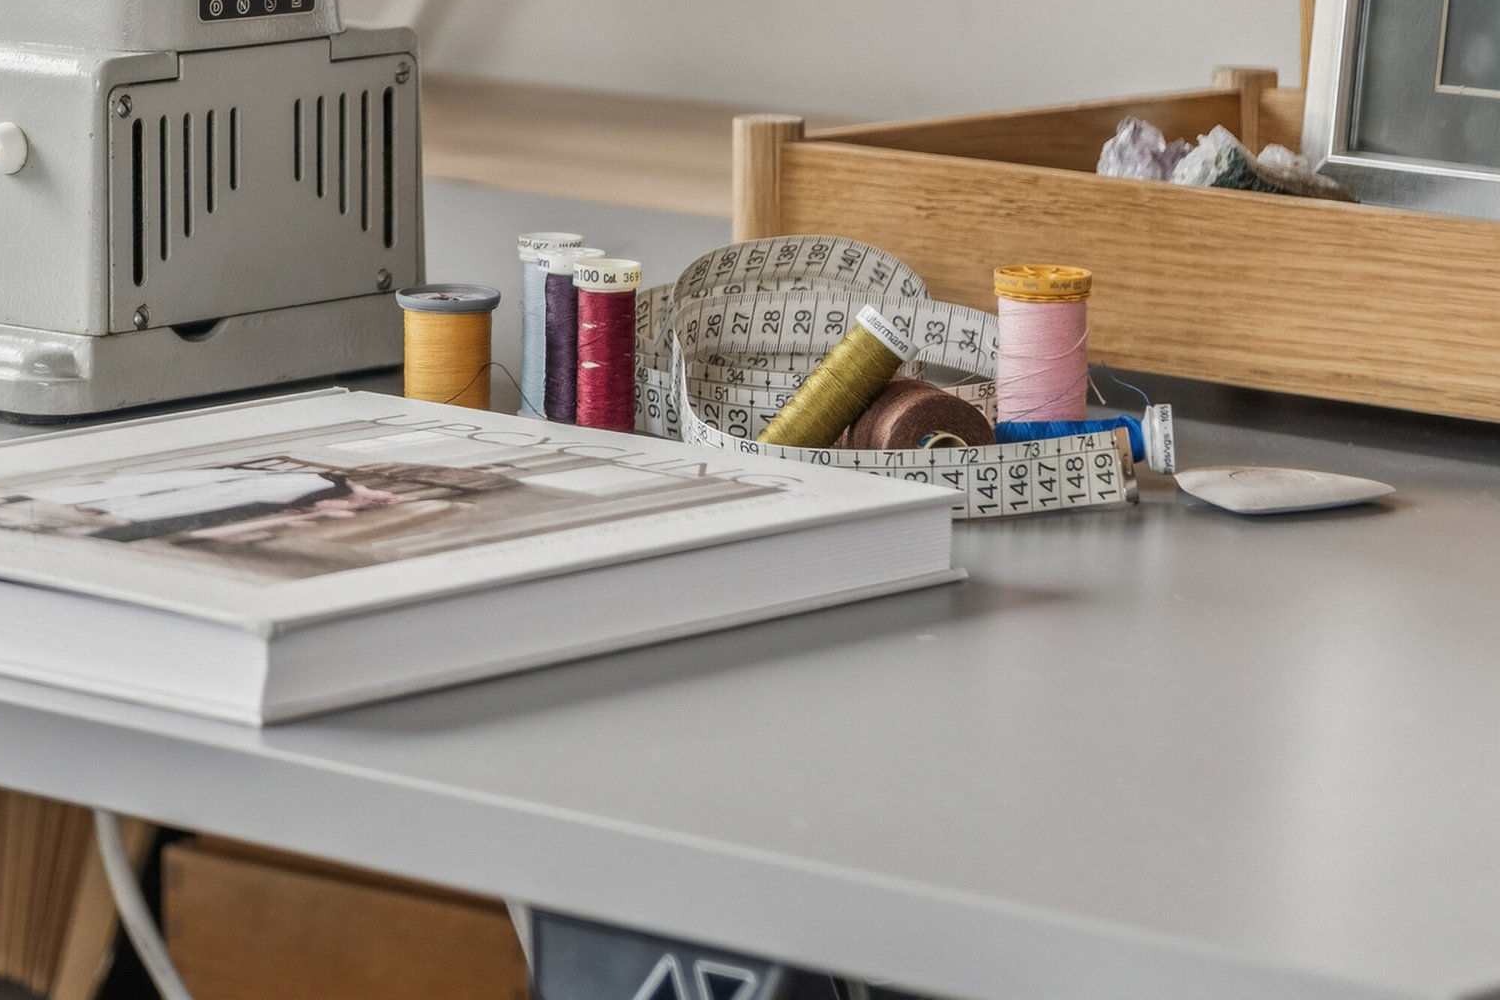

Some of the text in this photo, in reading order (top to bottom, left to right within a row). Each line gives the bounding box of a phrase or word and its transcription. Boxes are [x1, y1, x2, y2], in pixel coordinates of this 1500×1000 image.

[603, 274, 618, 284] Col.
[715, 251, 737, 278] 136
[745, 249, 766, 272] 137
[775, 244, 798, 268] 138
[805, 243, 829, 267] 139
[837, 248, 861, 272] 140
[869, 261, 892, 287] 141
[637, 300, 649, 334] 113
[687, 320, 698, 346] 25
[706, 314, 722, 339] 26
[732, 312, 750, 334] 27
[762, 310, 781, 334] 28
[793, 310, 812, 334] 29
[825, 310, 845, 335] 30
[925, 320, 945, 345] 33
[959, 328, 979, 353] 34
[727, 369, 744, 383] 34
[978, 382, 996, 398] 55
[648, 389, 660, 418] 99
[714, 387, 729, 401] 51
[705, 404, 720, 430] 02
[729, 409, 748, 438] 03
[373, 414, 803, 491] UPCYCLING
[740, 441, 759, 455] 69
[809, 450, 831, 465] 70
[884, 452, 904, 466] 71
[958, 448, 979, 464] 72
[1023, 442, 1041, 459] 73
[1077, 434, 1096, 450] 74
[977, 467, 999, 514] 145
[1009, 464, 1029, 511] 146
[1038, 462, 1057, 507] 147
[1066, 456, 1087, 503] 148
[1095, 453, 1117, 499] 149
